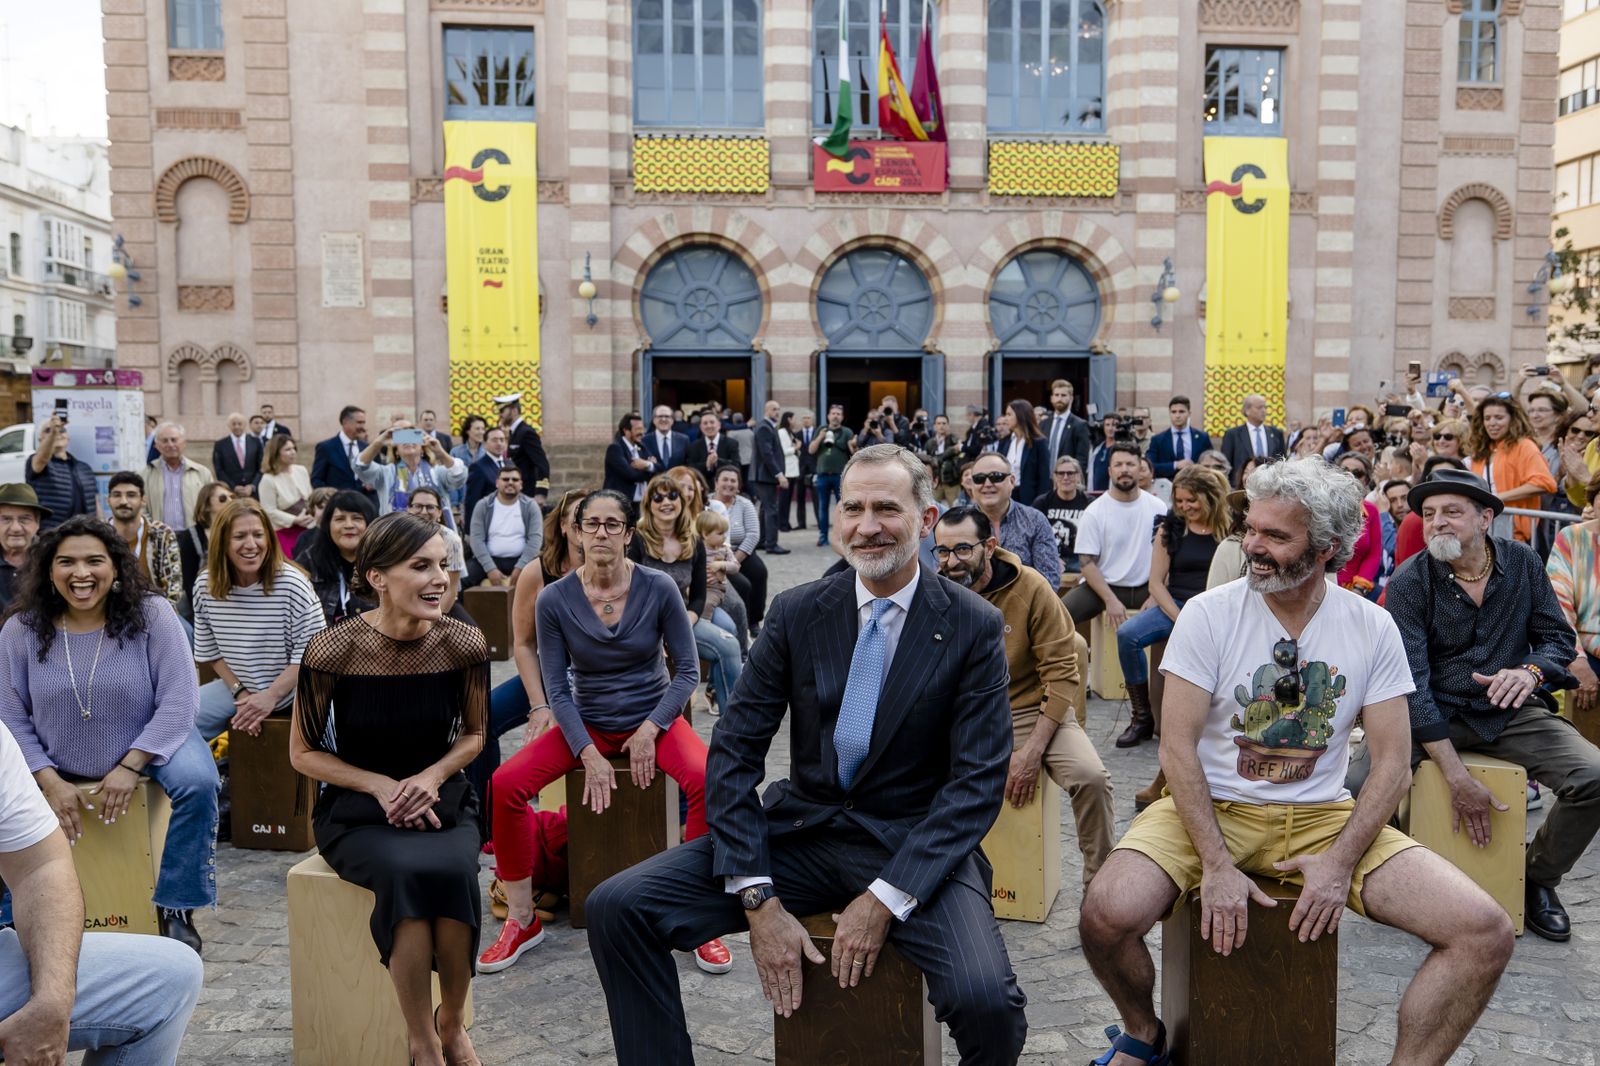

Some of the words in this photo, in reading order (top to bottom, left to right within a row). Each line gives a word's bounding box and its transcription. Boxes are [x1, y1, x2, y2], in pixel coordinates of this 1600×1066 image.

[476, 257, 510, 265] TEATRO
[1240, 753, 1277, 778] FREE
[1280, 760, 1311, 780] HUGS
